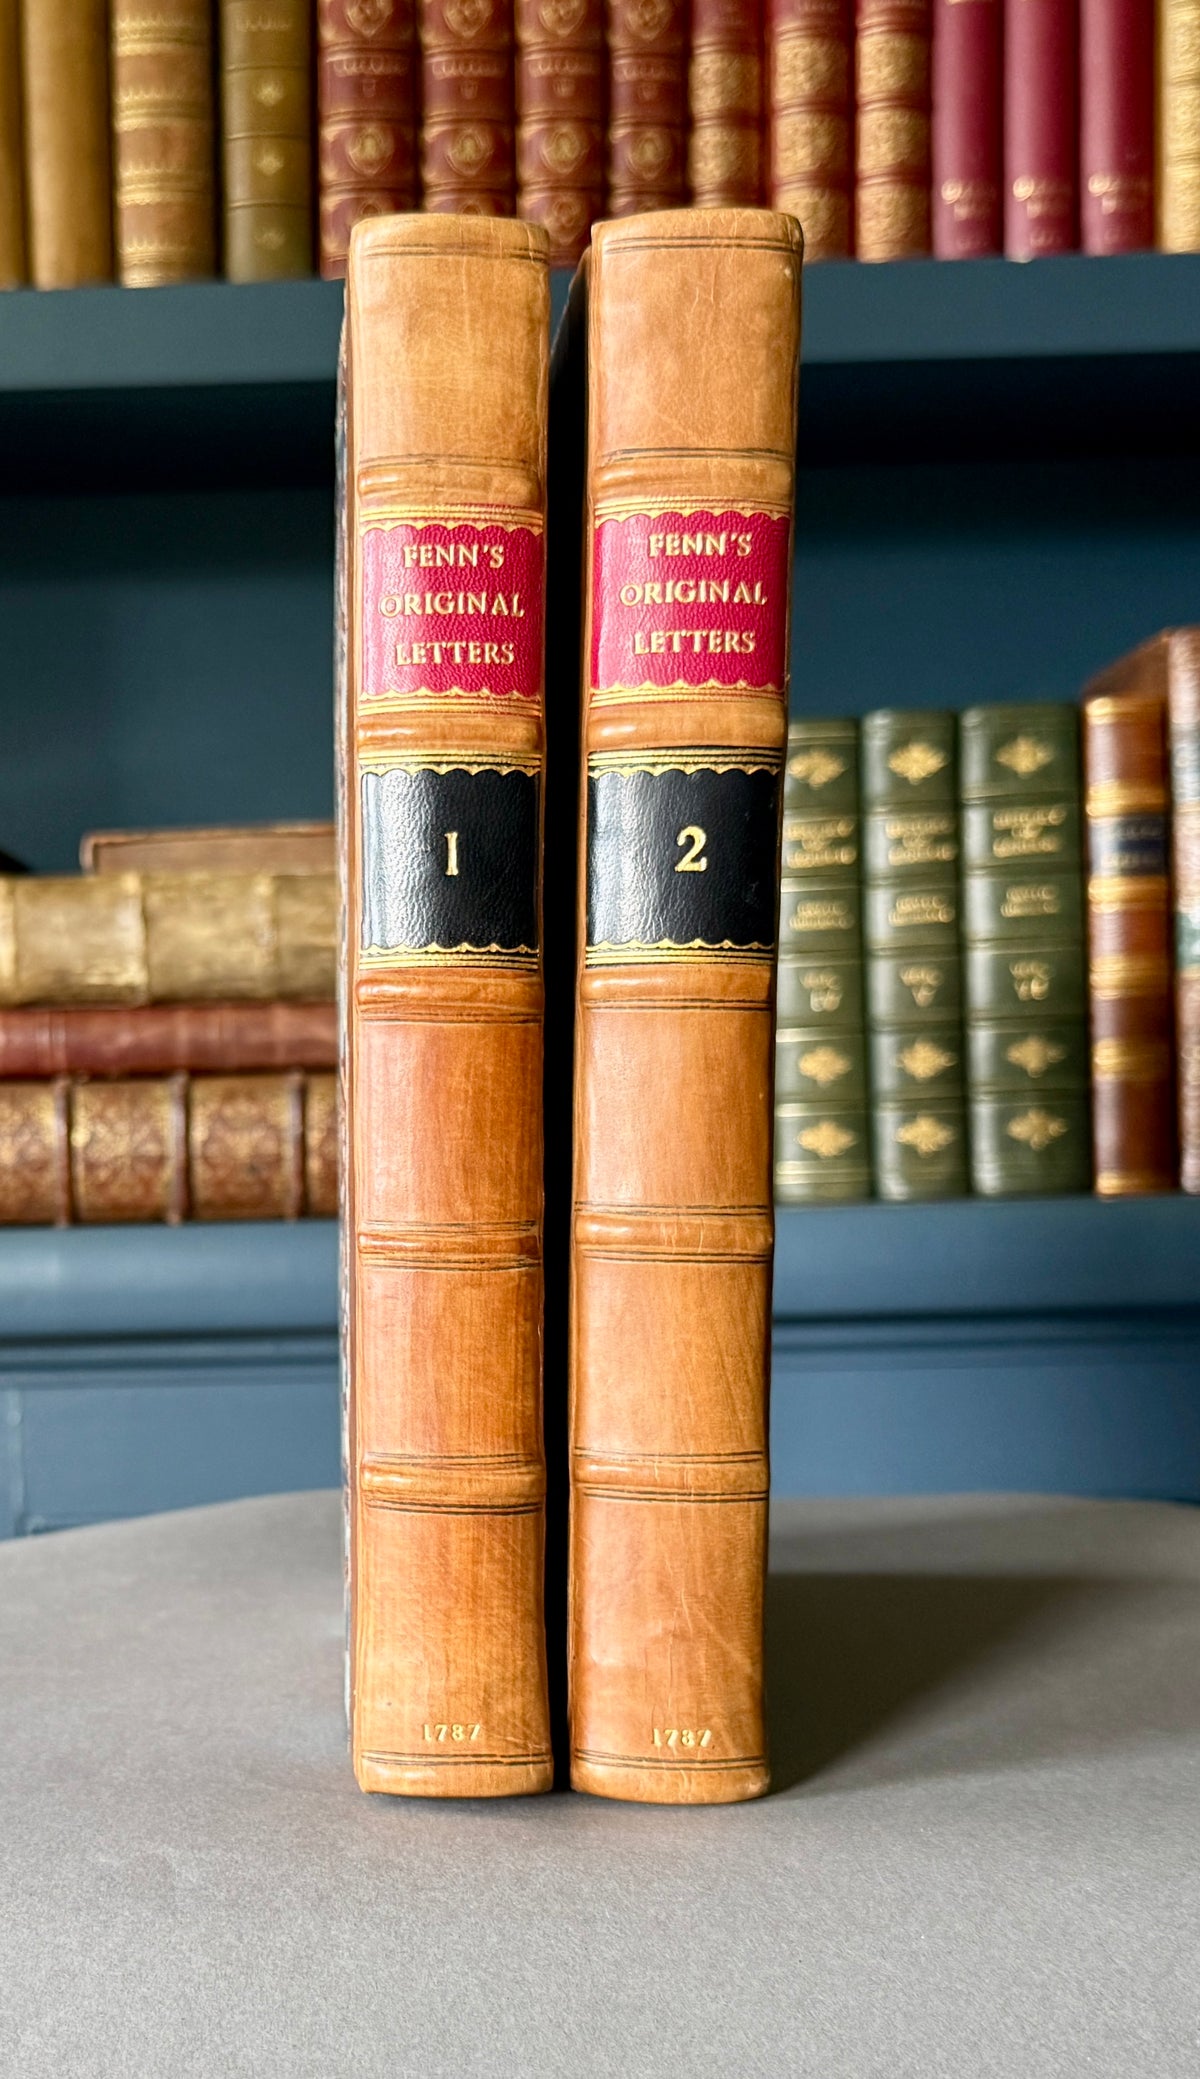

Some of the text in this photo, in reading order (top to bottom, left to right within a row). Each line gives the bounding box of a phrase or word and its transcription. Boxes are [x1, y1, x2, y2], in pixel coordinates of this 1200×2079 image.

[403, 543, 505, 568] FENN'S
[649, 531, 753, 558] FENN'S
[379, 592, 526, 618] ORIGINAL
[619, 580, 768, 607] ORIGINAL
[396, 641, 515, 666] LETTERS
[634, 628, 757, 655] LETTERS
[444, 831, 459, 876] 1
[674, 825, 708, 873] 2
[422, 1723, 481, 1742] 1787
[652, 1728, 712, 1748] 1787
